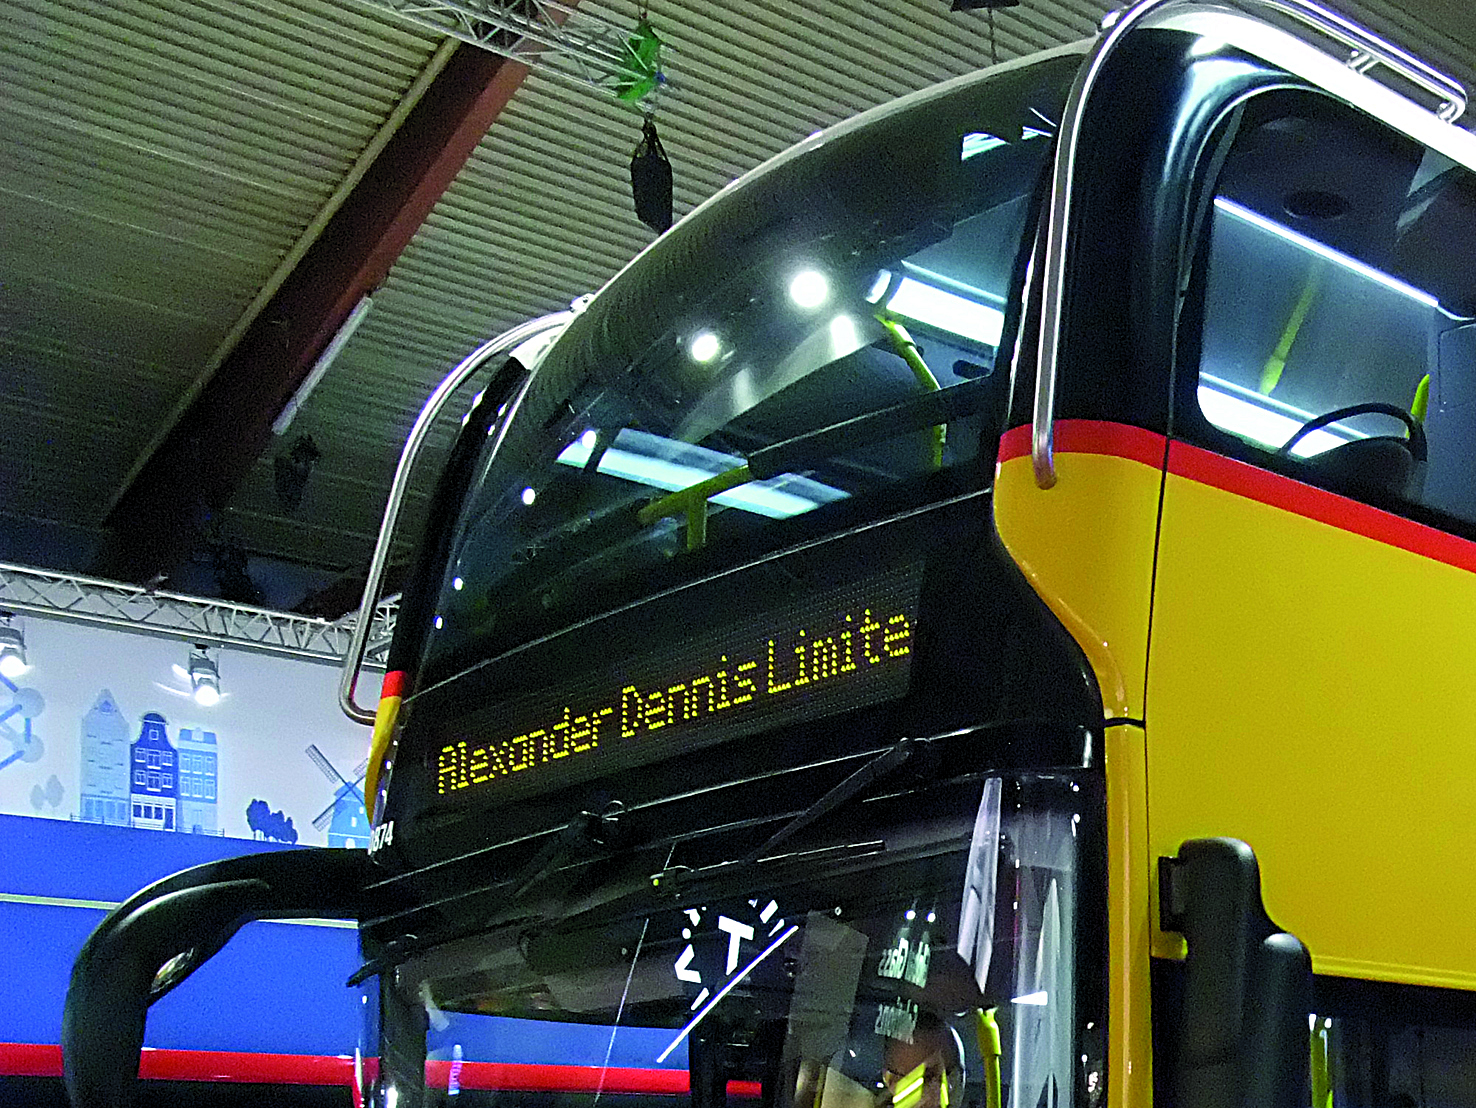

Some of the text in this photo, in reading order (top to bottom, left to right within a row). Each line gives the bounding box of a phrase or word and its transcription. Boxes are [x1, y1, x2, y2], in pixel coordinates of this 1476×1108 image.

[438, 608, 910, 794] Alexander Dennis Limite
